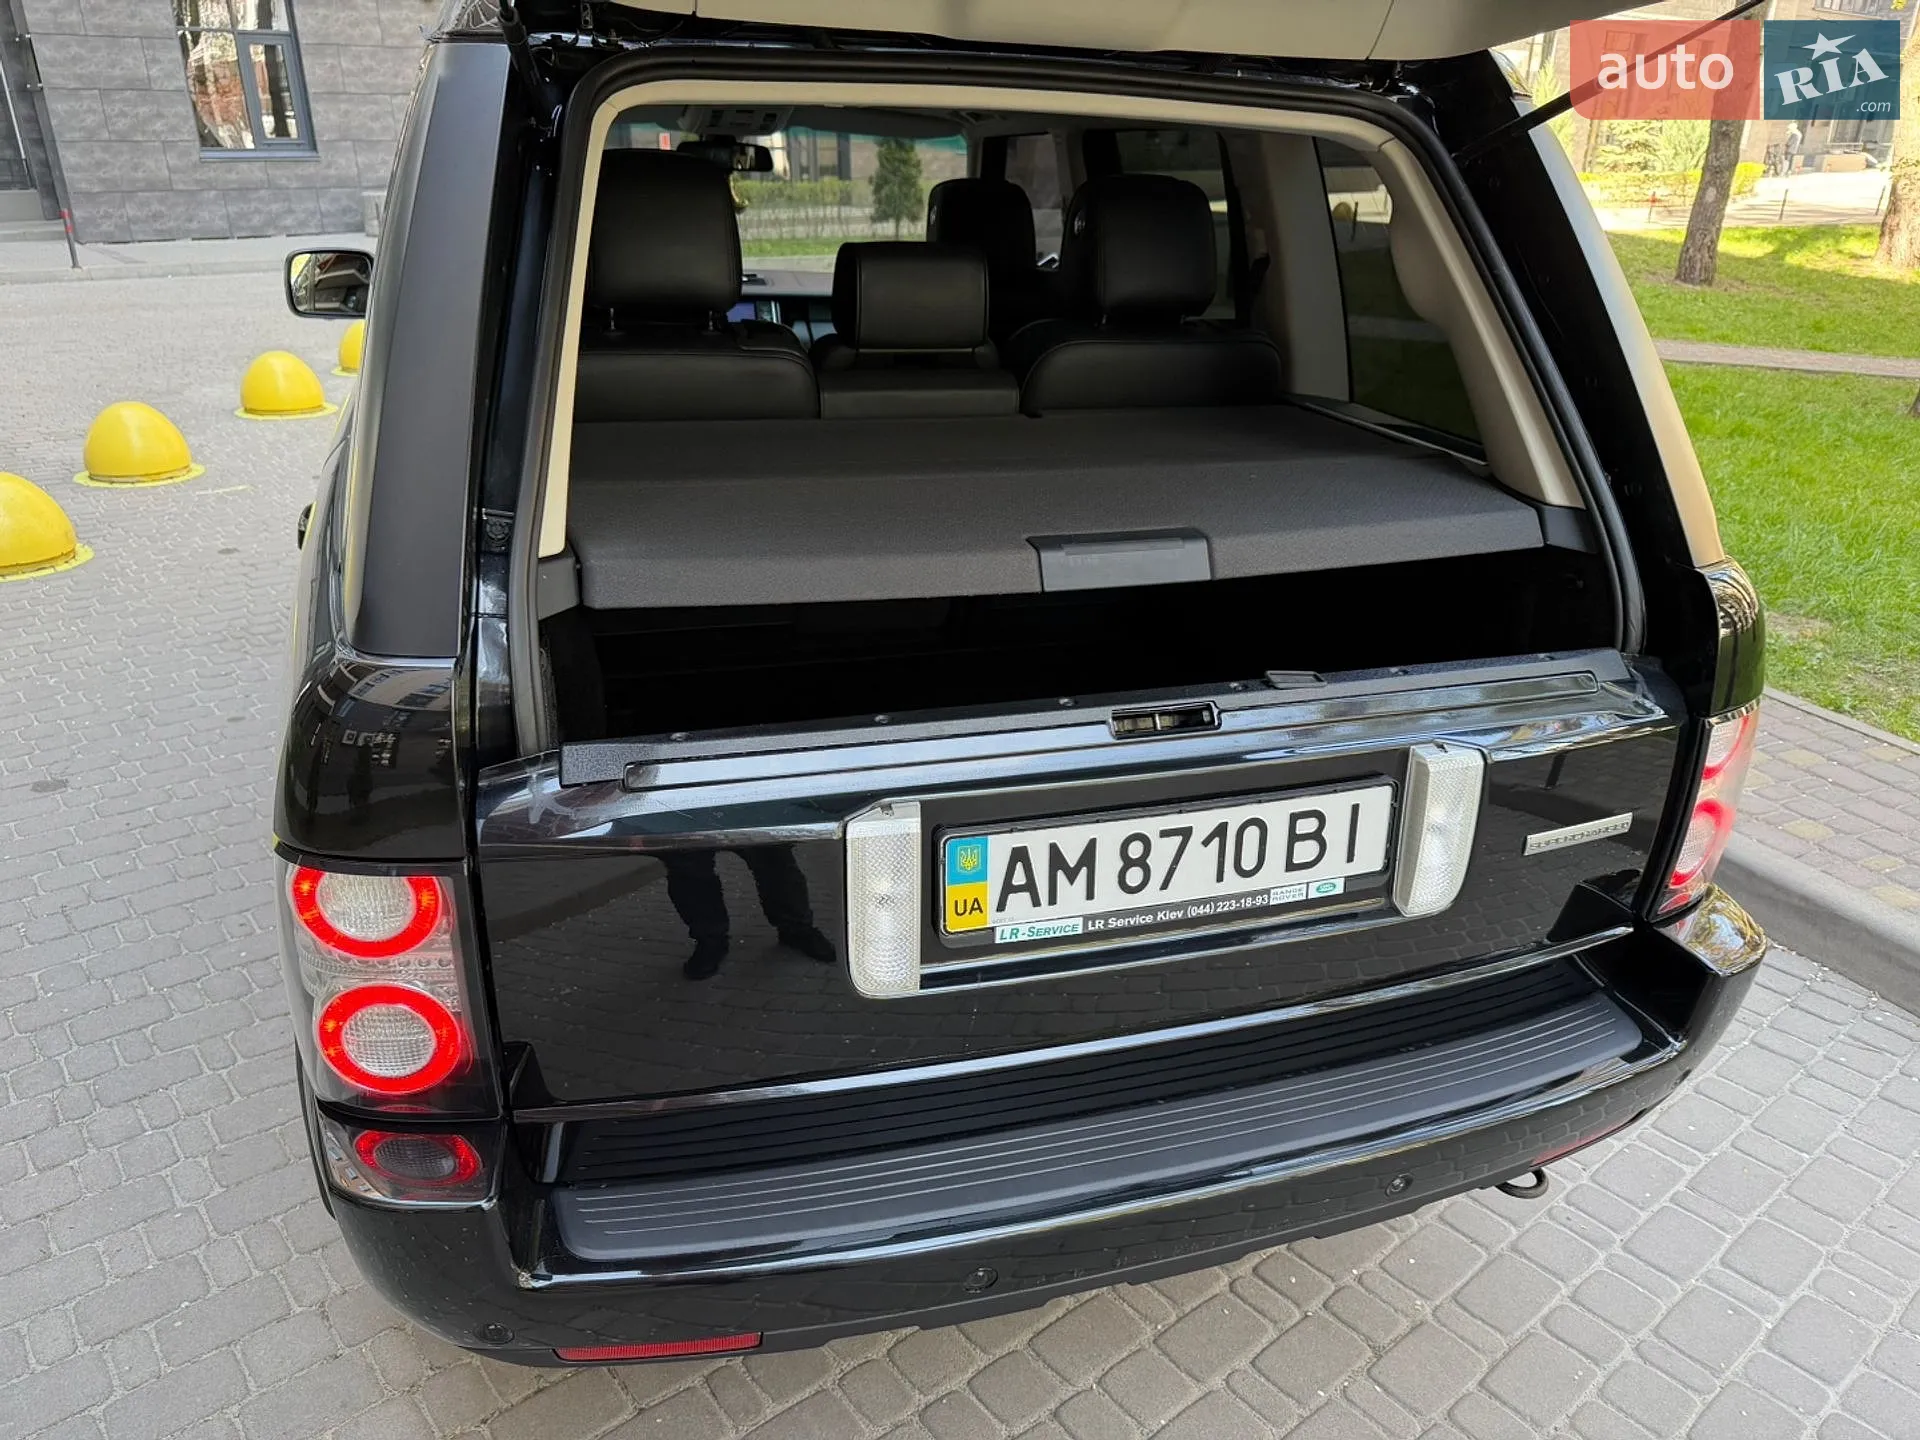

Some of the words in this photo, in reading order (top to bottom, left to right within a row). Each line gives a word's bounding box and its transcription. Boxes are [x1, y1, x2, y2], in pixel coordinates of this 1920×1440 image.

[995, 837, 1097, 912] AM
[1118, 817, 1268, 896] 8710
[954, 897, 984, 917] UA
[1088, 918, 1105, 931] LR
[1108, 913, 1153, 929] Service
[1157, 909, 1183, 922] Kiev
[1187, 902, 1215, 919] (044)
[1217, 894, 1268, 912] 223-18-93
